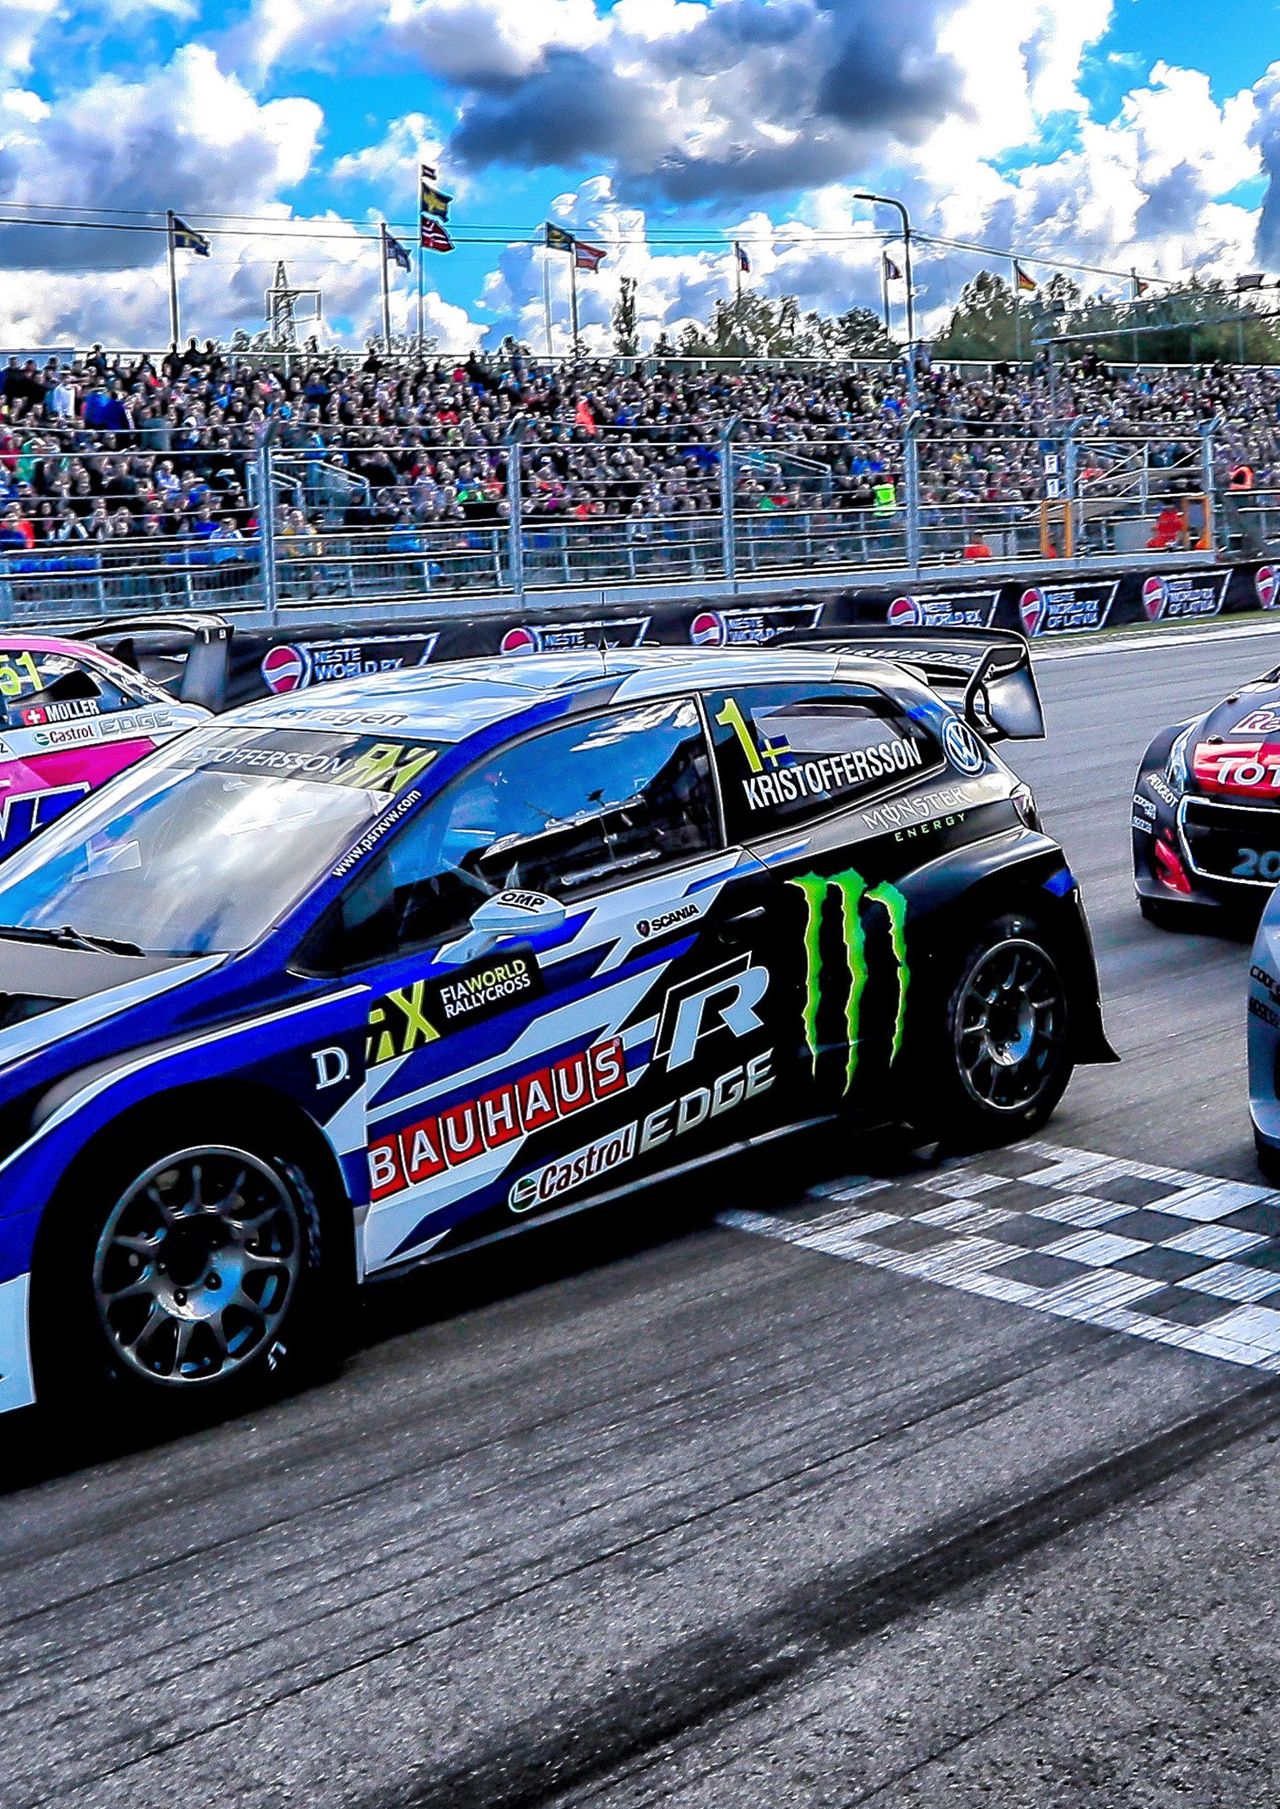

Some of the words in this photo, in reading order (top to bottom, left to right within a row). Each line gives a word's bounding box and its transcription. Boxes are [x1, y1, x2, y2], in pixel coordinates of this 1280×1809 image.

[314, 648, 361, 663] NESTE
[314, 658, 378, 681] WORLD
[49, 725, 94, 744] Castrol
[99, 711, 173, 735] EDGE
[715, 698, 763, 774] 1
[742, 738, 923, 811] KRISTOFFERSSON
[332, 788, 422, 879] www.psrxvw.com
[894, 812, 967, 842] ENERGY
[500, 890, 546, 909] OMP
[651, 903, 701, 932] SCANIA
[445, 974, 531, 1019] RALLYCROSS
[662, 962, 770, 1072] R
[367, 1040, 623, 1192] BAUHAUS
[538, 1128, 634, 1201] Castrol
[638, 1048, 777, 1155] EDGE
